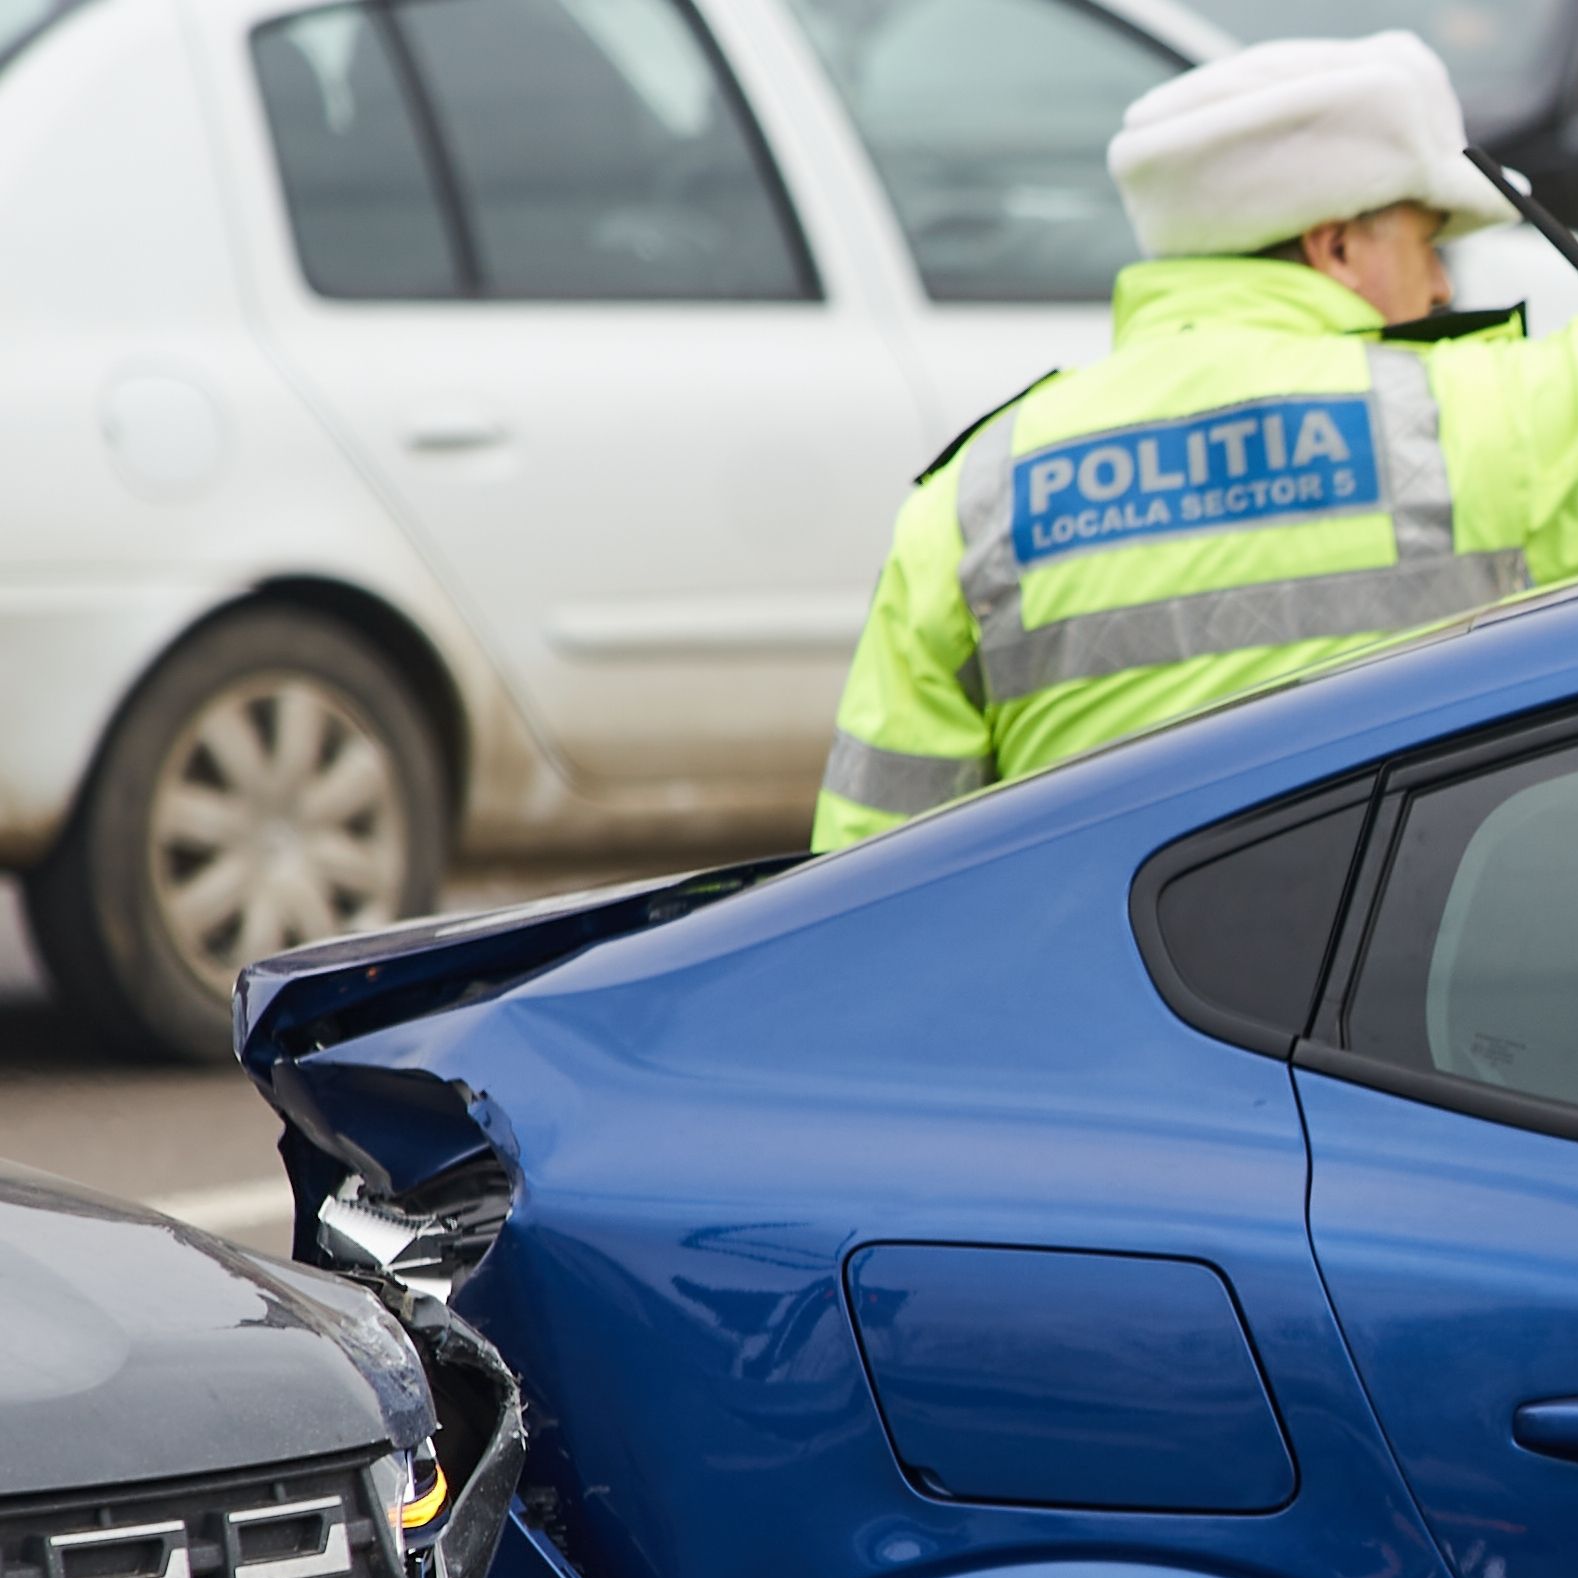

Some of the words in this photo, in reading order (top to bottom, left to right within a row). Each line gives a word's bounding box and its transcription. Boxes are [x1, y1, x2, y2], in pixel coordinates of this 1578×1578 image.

[1029, 408, 1350, 516] POLITIA
[1031, 499, 1172, 550] LOCALA
[1180, 474, 1323, 522] SECTOR
[1332, 468, 1357, 498] 5
